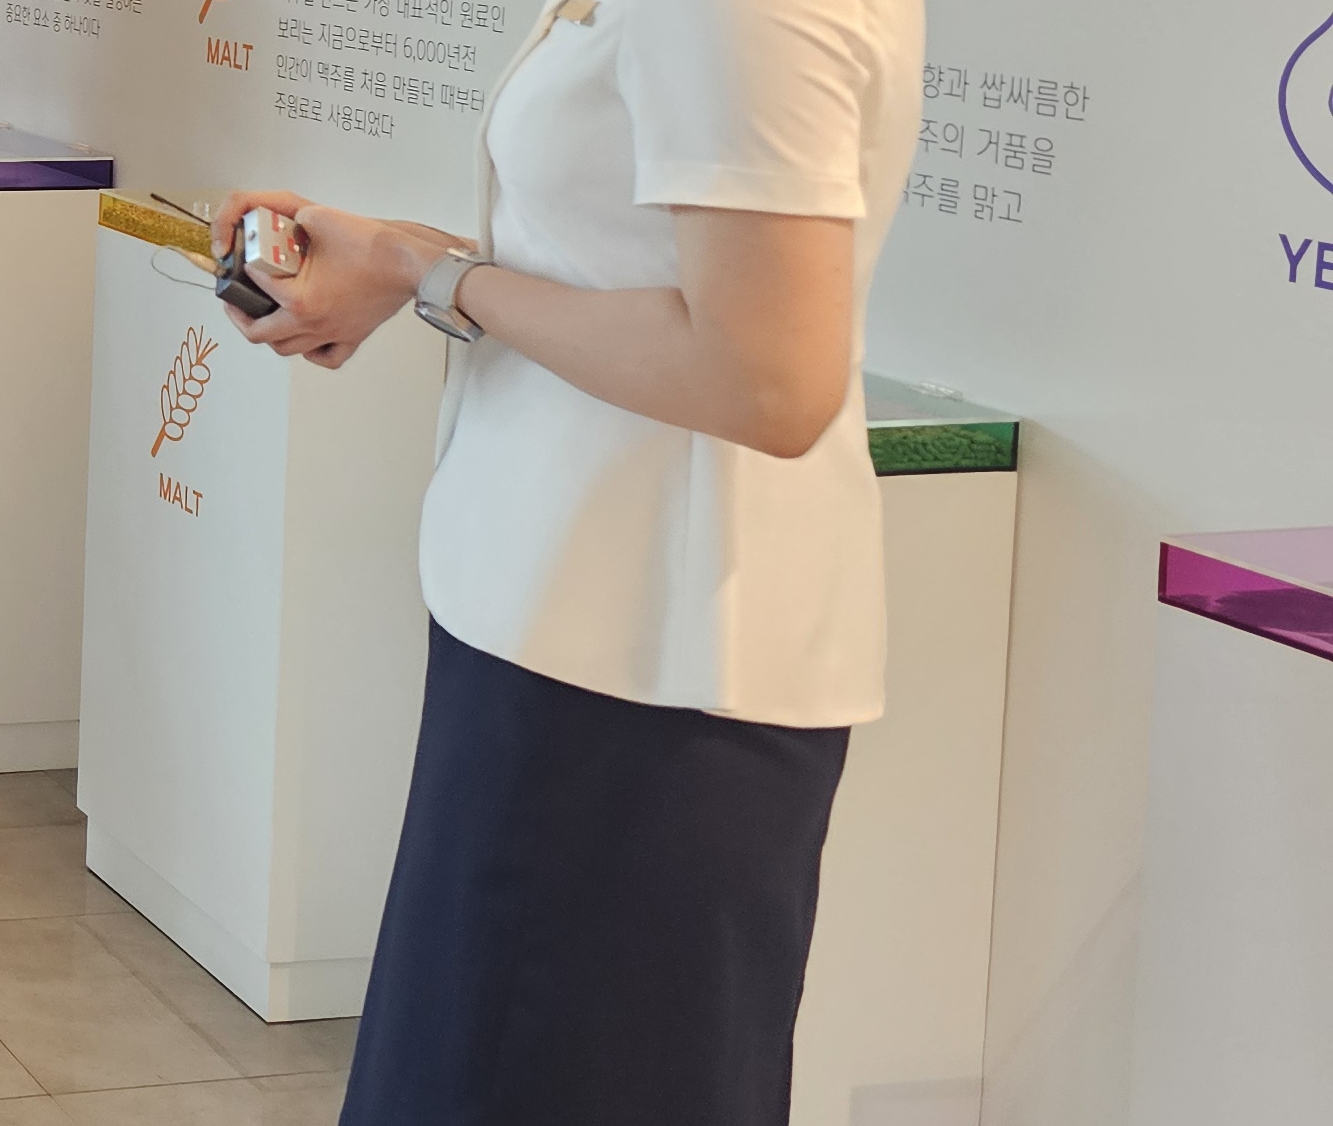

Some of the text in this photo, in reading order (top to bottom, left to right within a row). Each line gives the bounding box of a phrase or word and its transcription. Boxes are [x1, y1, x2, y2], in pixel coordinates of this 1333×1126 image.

[6, 3, 101, 39] 중요한 요소 중 하나이다
[460, 2, 505, 33] 원료인
[206, 37, 254, 71] MALT
[277, 18, 476, 72] 보리는 지금으로부터 6,000년전
[276, 55, 485, 113] 인간이 맥주를 처음 만들던 때부터
[979, 72, 1090, 121] 쌉싸름한
[274, 93, 395, 139] 주원료로 사용되었다
[976, 128, 1056, 176] 거품을
[973, 184, 1023, 224] 맑고
[158, 472, 203, 517] MALT
